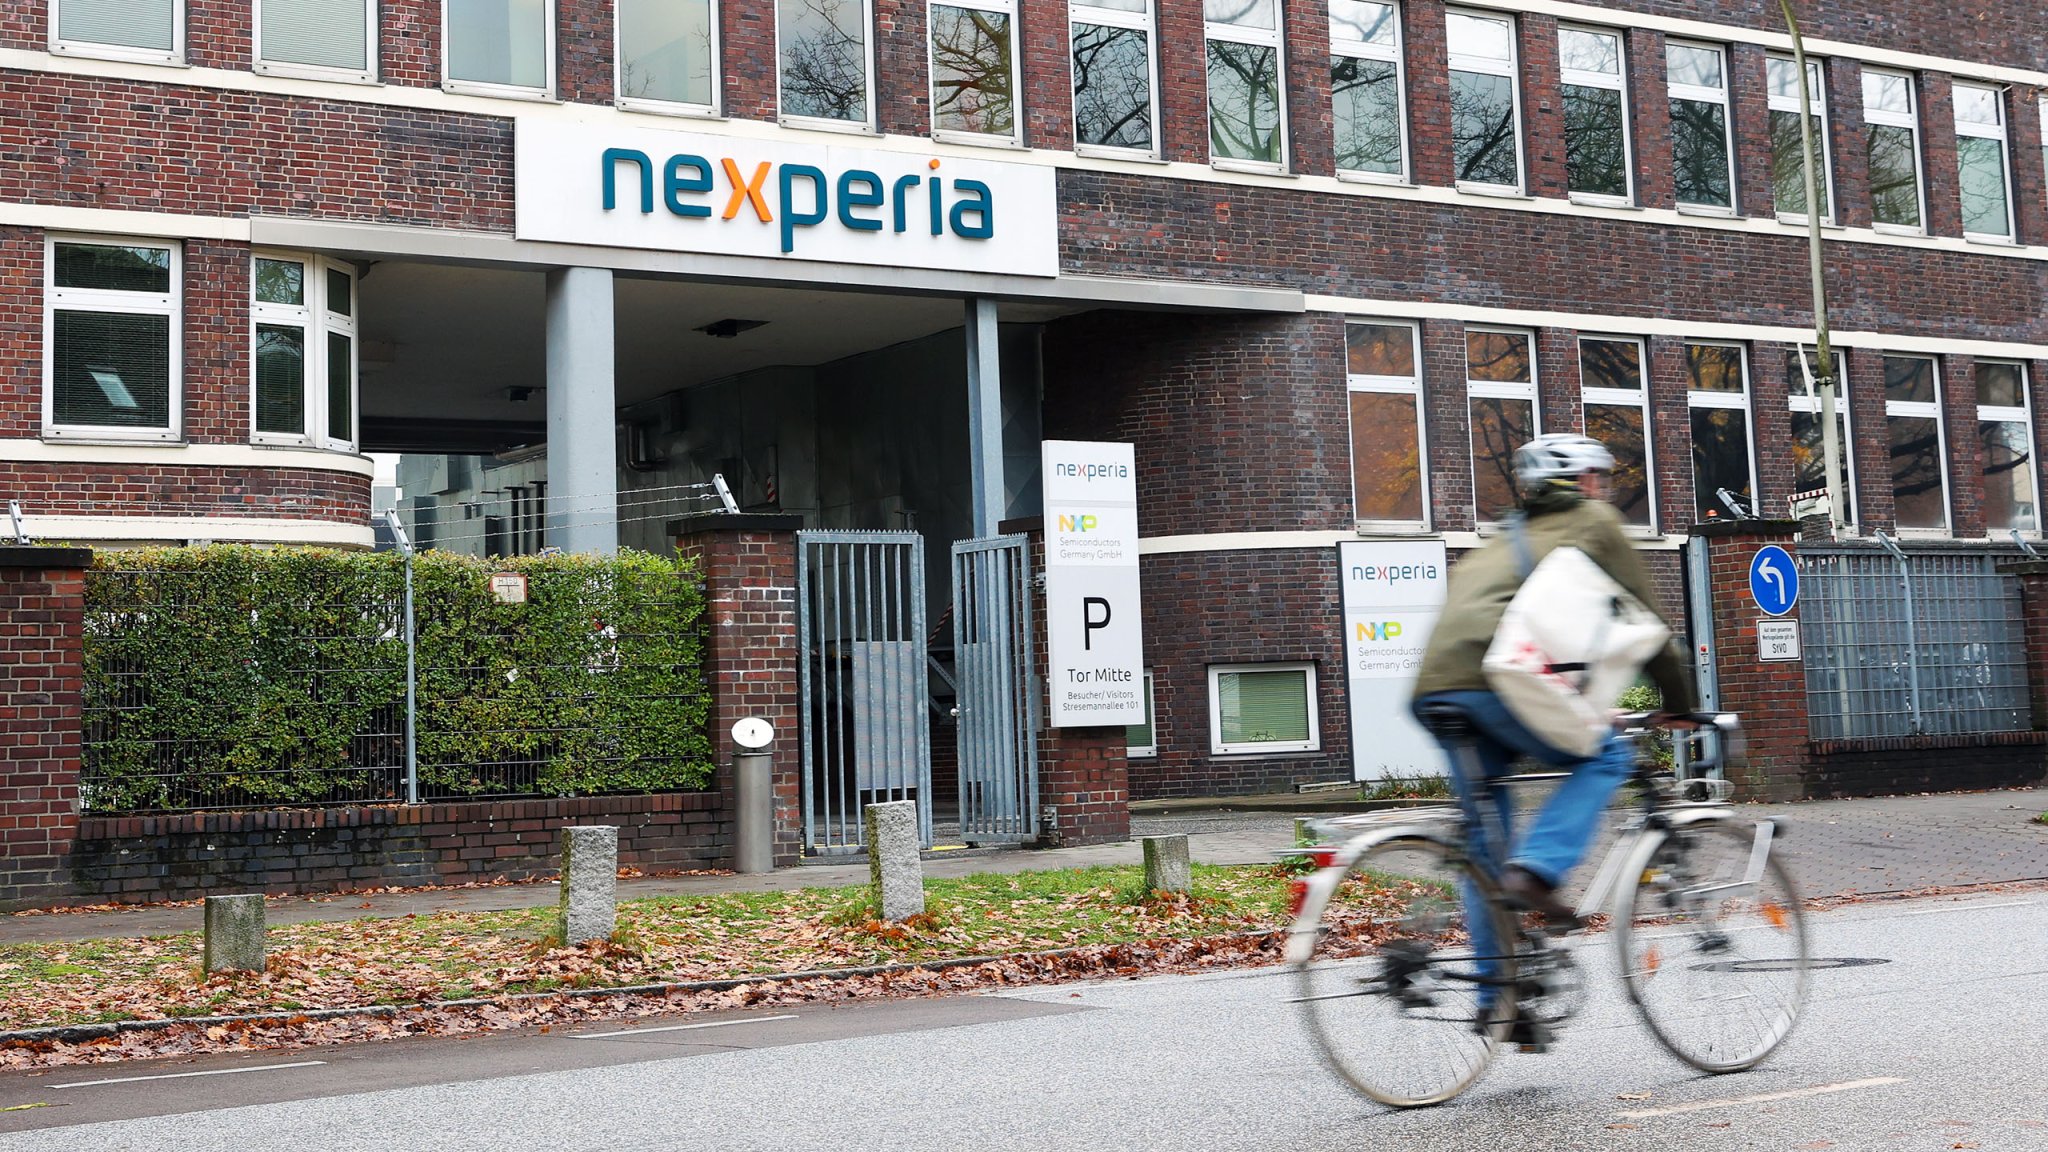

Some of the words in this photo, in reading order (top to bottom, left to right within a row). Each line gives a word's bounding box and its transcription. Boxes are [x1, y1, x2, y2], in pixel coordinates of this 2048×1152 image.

[602, 147, 993, 252] nexperia
[1057, 462, 1127, 482] nexperia
[1058, 514, 1097, 532] NXP
[1060, 537, 1121, 547] Semiconductors
[1060, 549, 1095, 560] Germany
[1097, 549, 1122, 559] GmbH
[1352, 562, 1437, 585] nexperia
[1083, 597, 1111, 650] P
[1356, 622, 1402, 641] NXP
[1358, 646, 1426, 657] Semiconductor
[1772, 643, 1787, 654] StVO
[1359, 660, 1400, 671] Germany
[1067, 668, 1091, 683] Tor
[1095, 668, 1131, 682] Mitte
[1067, 690, 1105, 700] Besucher/
[1106, 690, 1134, 699] Visitors
[1063, 702, 1124, 711] Stresemannallee
[1126, 701, 1139, 710] 101
